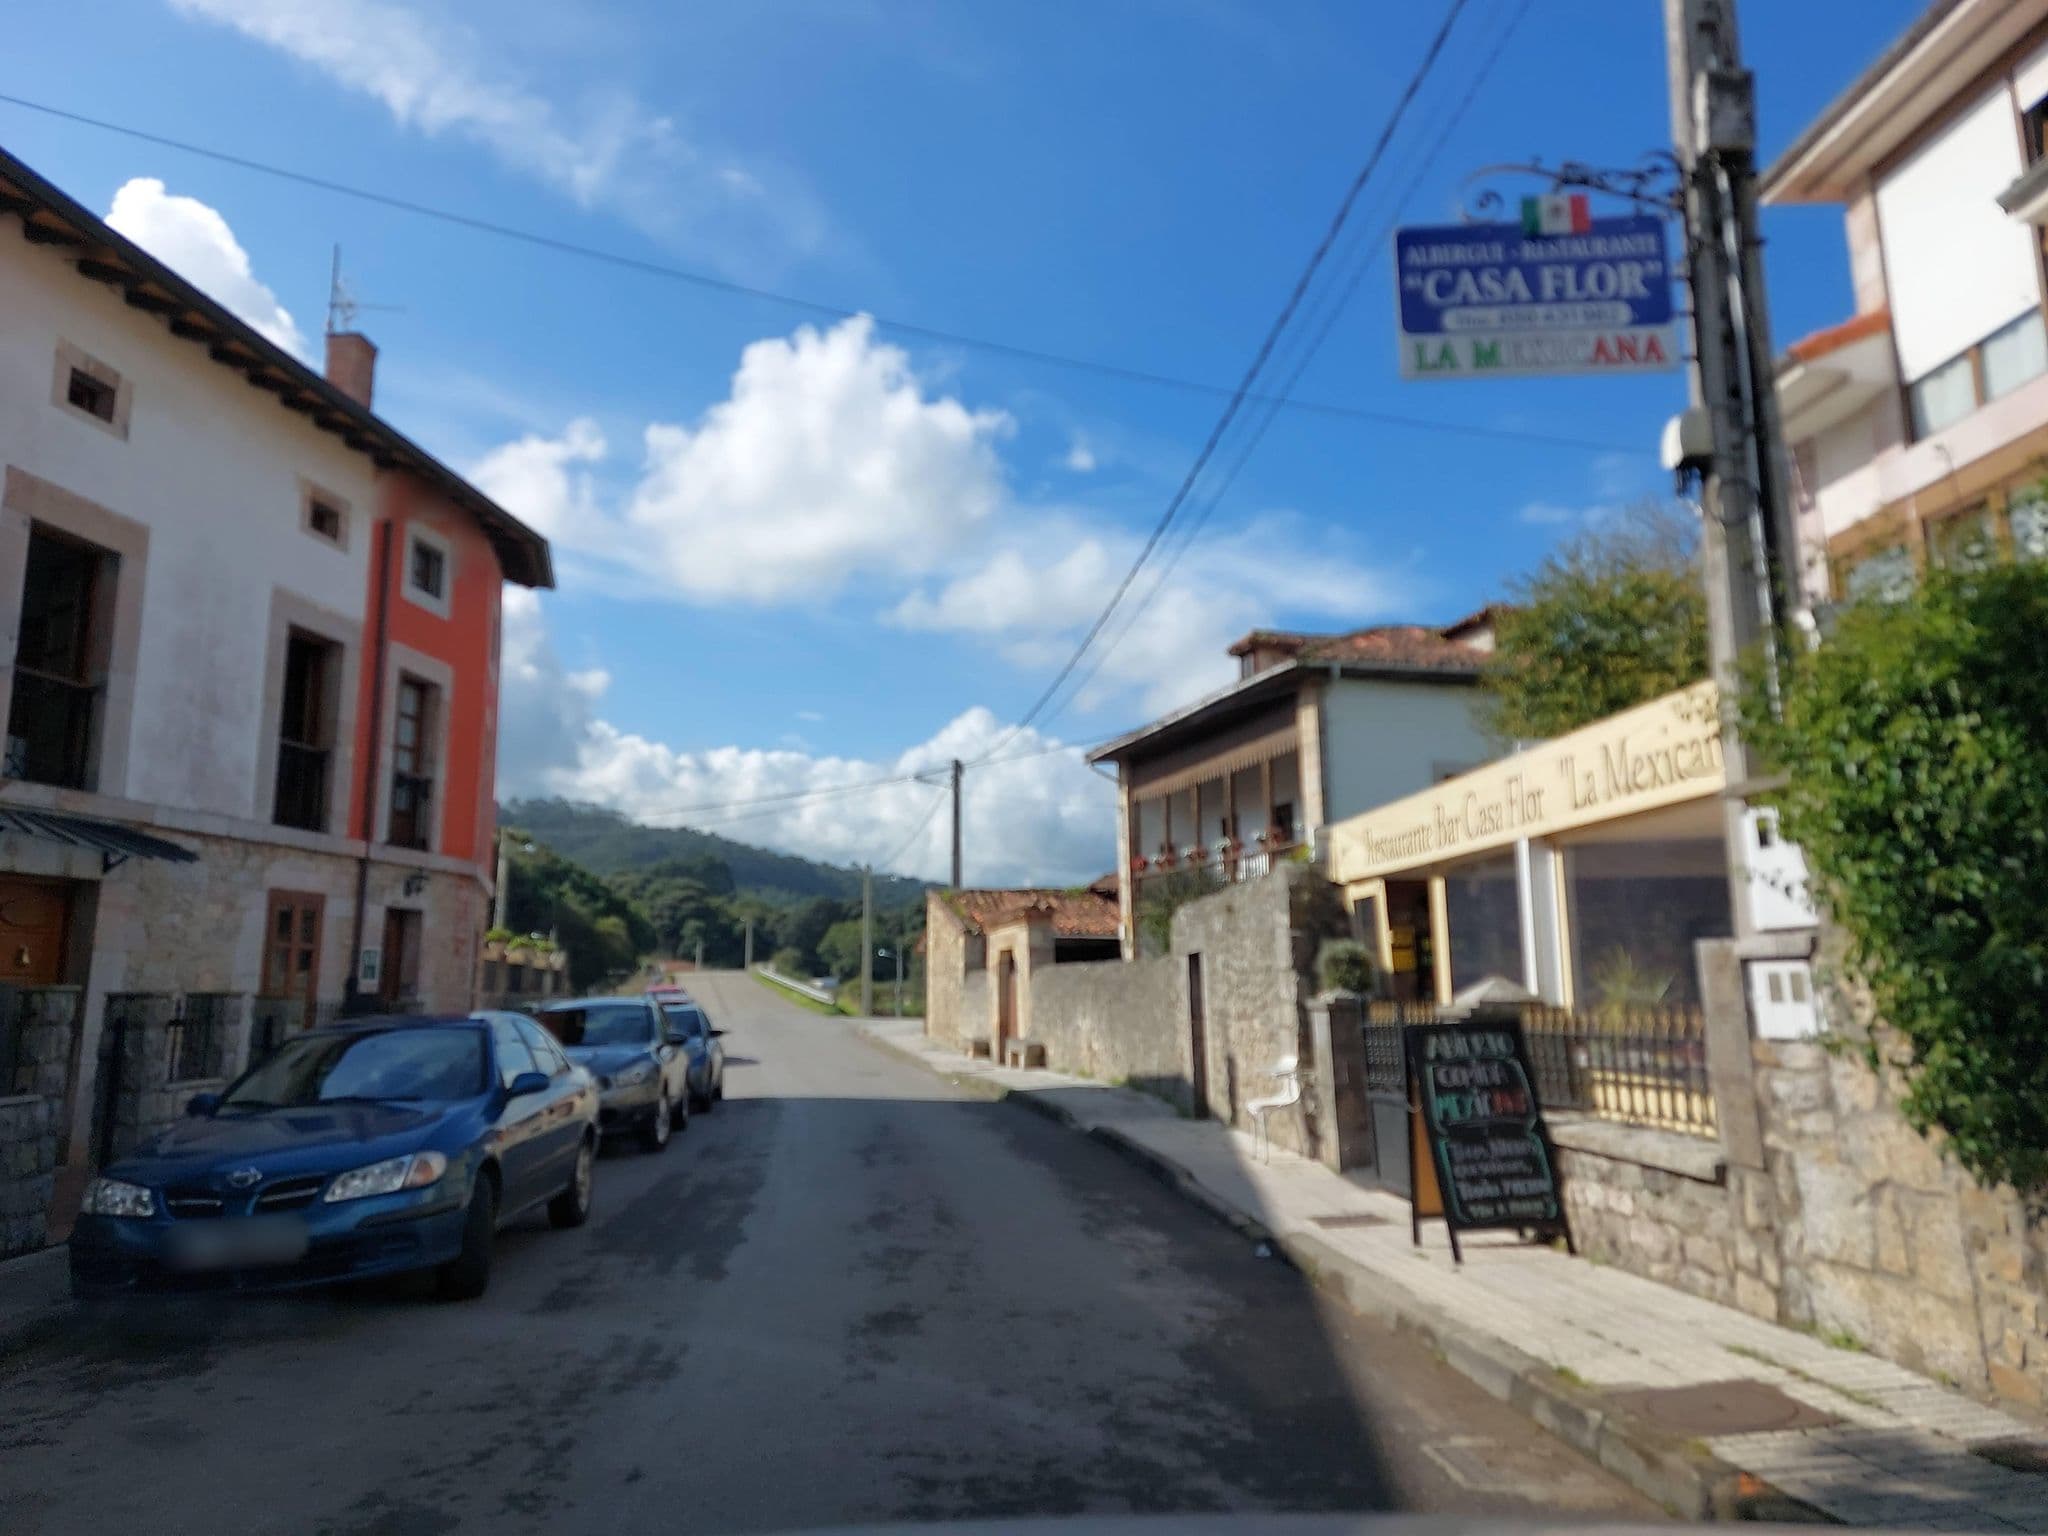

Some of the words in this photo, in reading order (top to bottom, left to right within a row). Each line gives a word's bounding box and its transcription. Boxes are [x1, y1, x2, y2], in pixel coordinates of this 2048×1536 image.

[1415, 341, 1458, 371] LA
[1365, 822, 1434, 866] Restaurante
[1434, 803, 1463, 849] Bar
[1464, 790, 1503, 841] Casa
[1506, 771, 1545, 828] Flor
